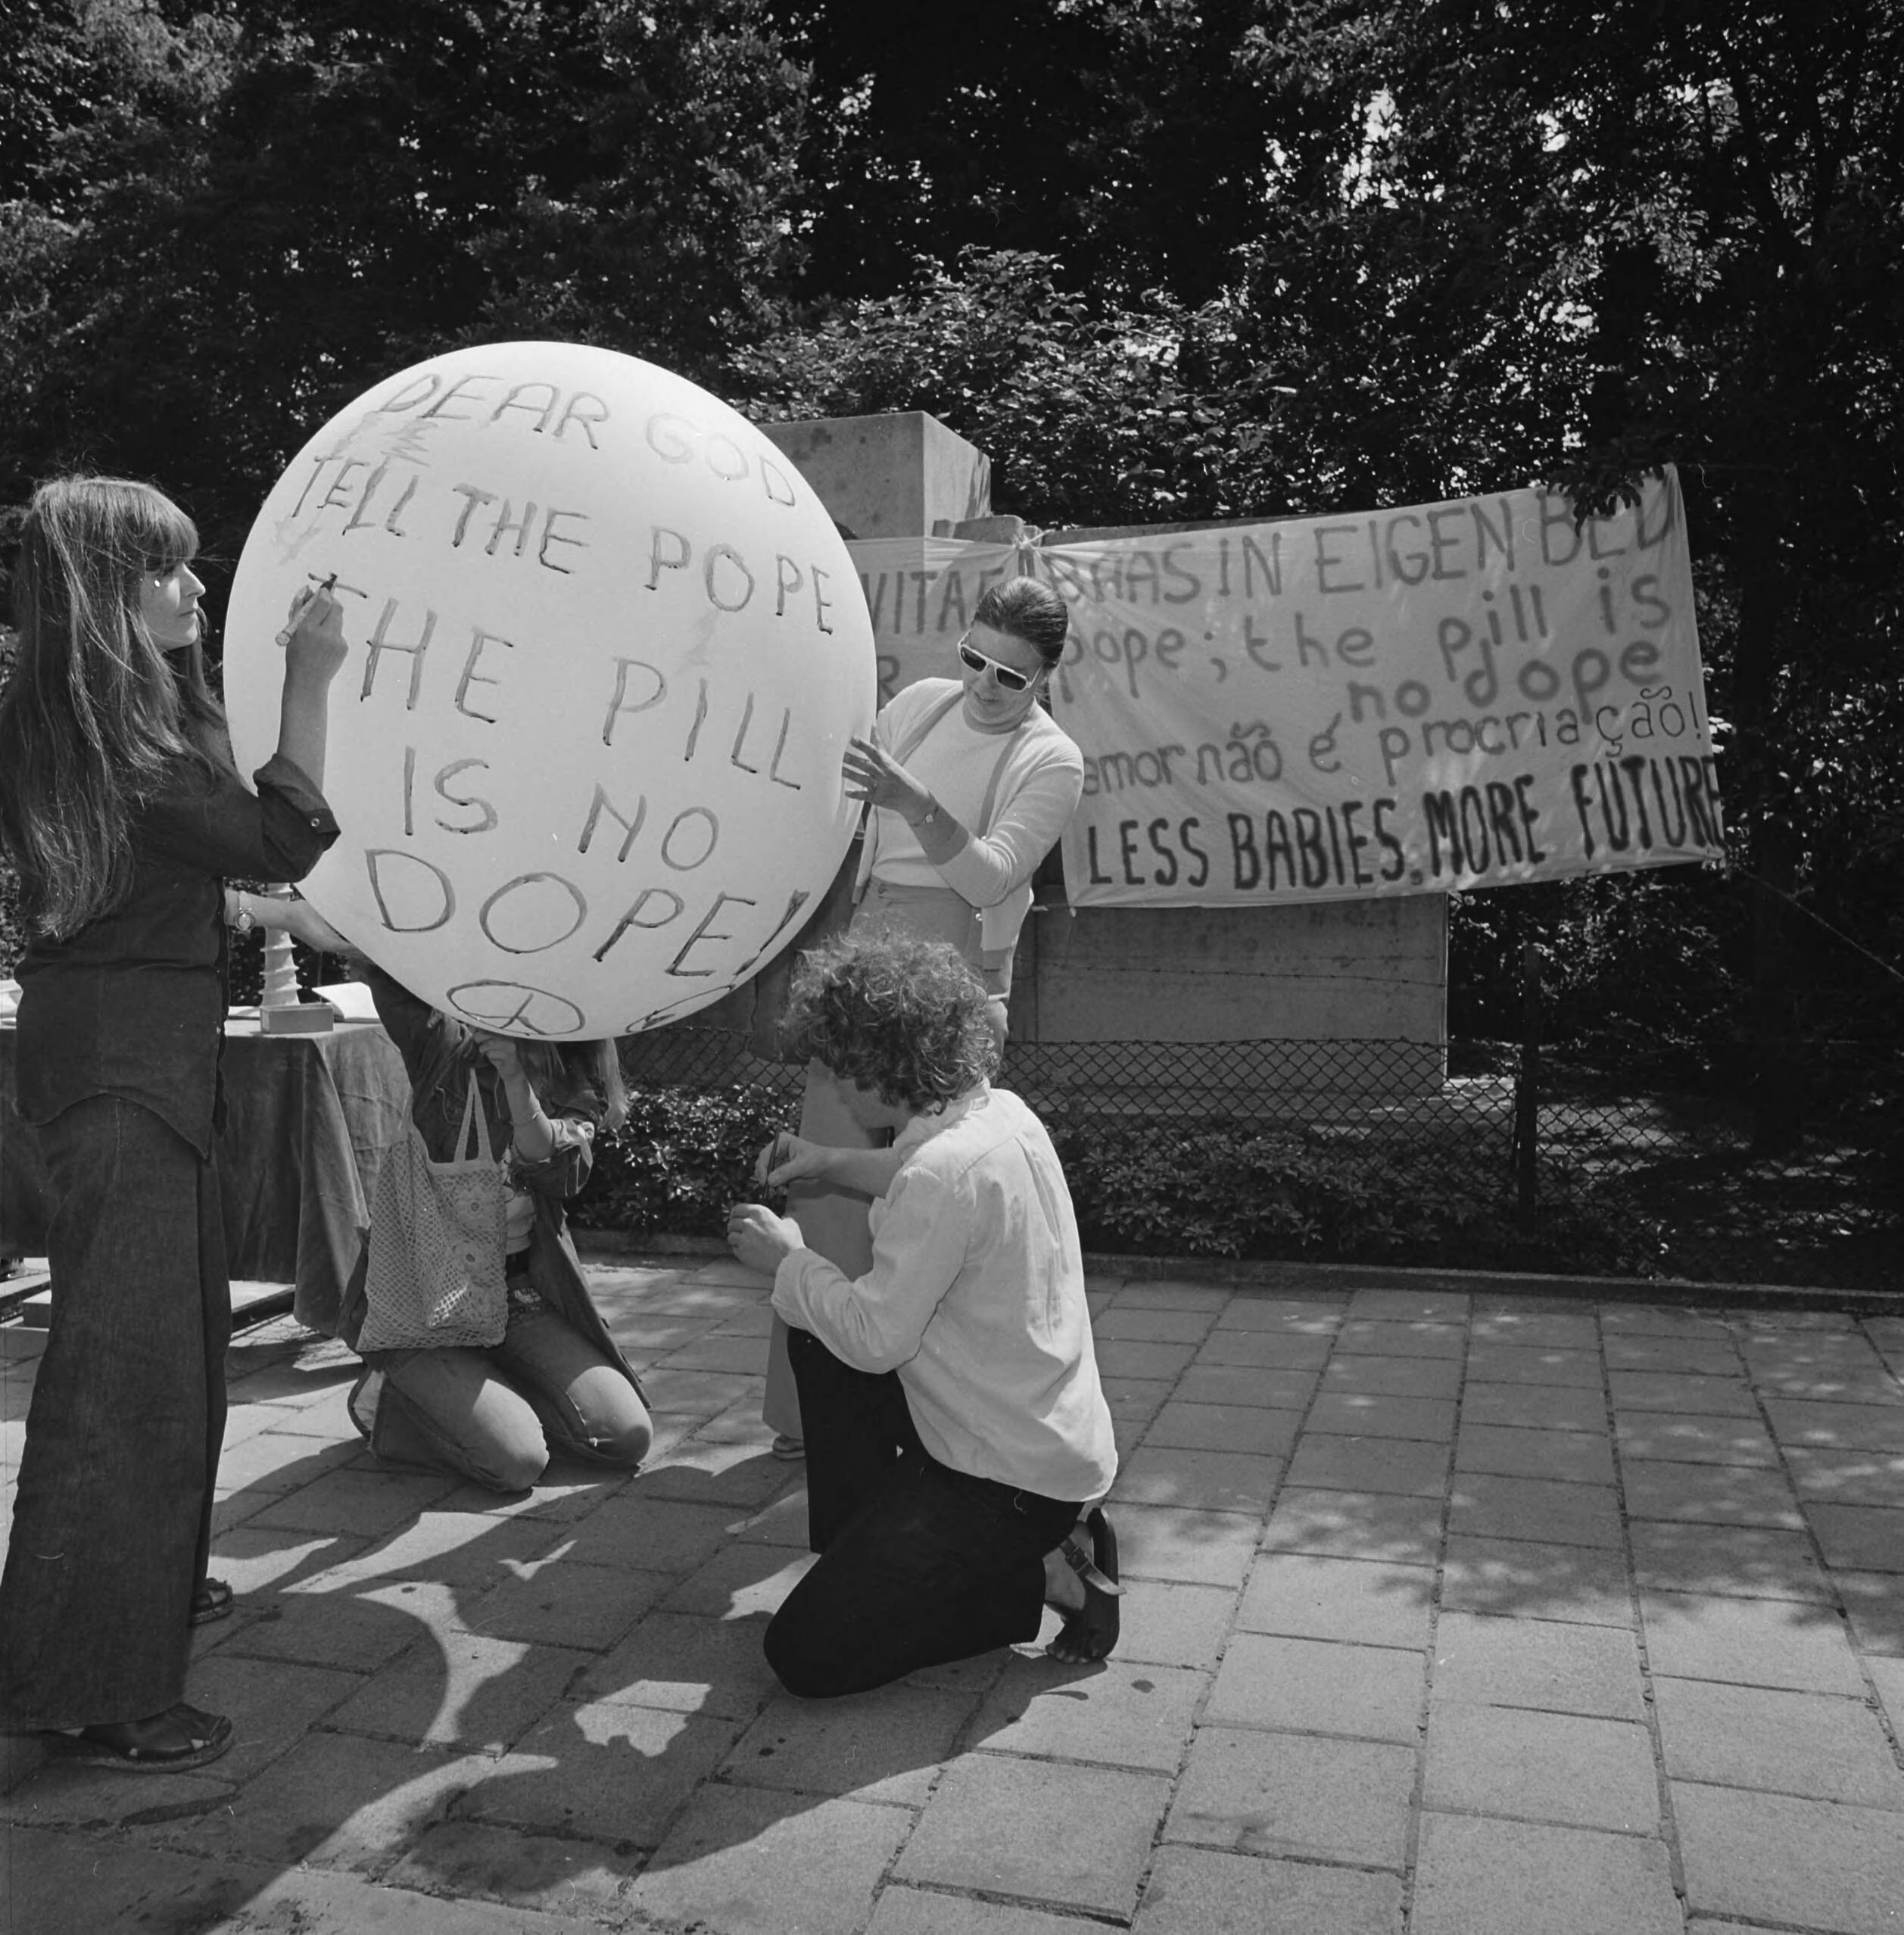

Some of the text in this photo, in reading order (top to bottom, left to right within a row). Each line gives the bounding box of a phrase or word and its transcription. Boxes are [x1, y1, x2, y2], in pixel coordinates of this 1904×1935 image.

[380, 373, 796, 507] DEAR GOD
[291, 454, 834, 635] TELL THE POPE
[1219, 533, 1282, 598] IN
[1313, 497, 1513, 594] EIGEN
[1244, 612, 1376, 672] the
[1439, 583, 1547, 681] pill
[1597, 567, 1671, 634] is
[1348, 638, 1662, 725] no dope
[603, 656, 800, 790] PILL
[1197, 721, 1283, 785] não
[1308, 712, 1342, 773] é
[404, 746, 718, 871] IS NO
[1088, 817, 1209, 887] LESS
[1423, 774, 1546, 877] MORE
[1570, 755, 1723, 861] FUTURE
[366, 848, 809, 977] DOPE!
